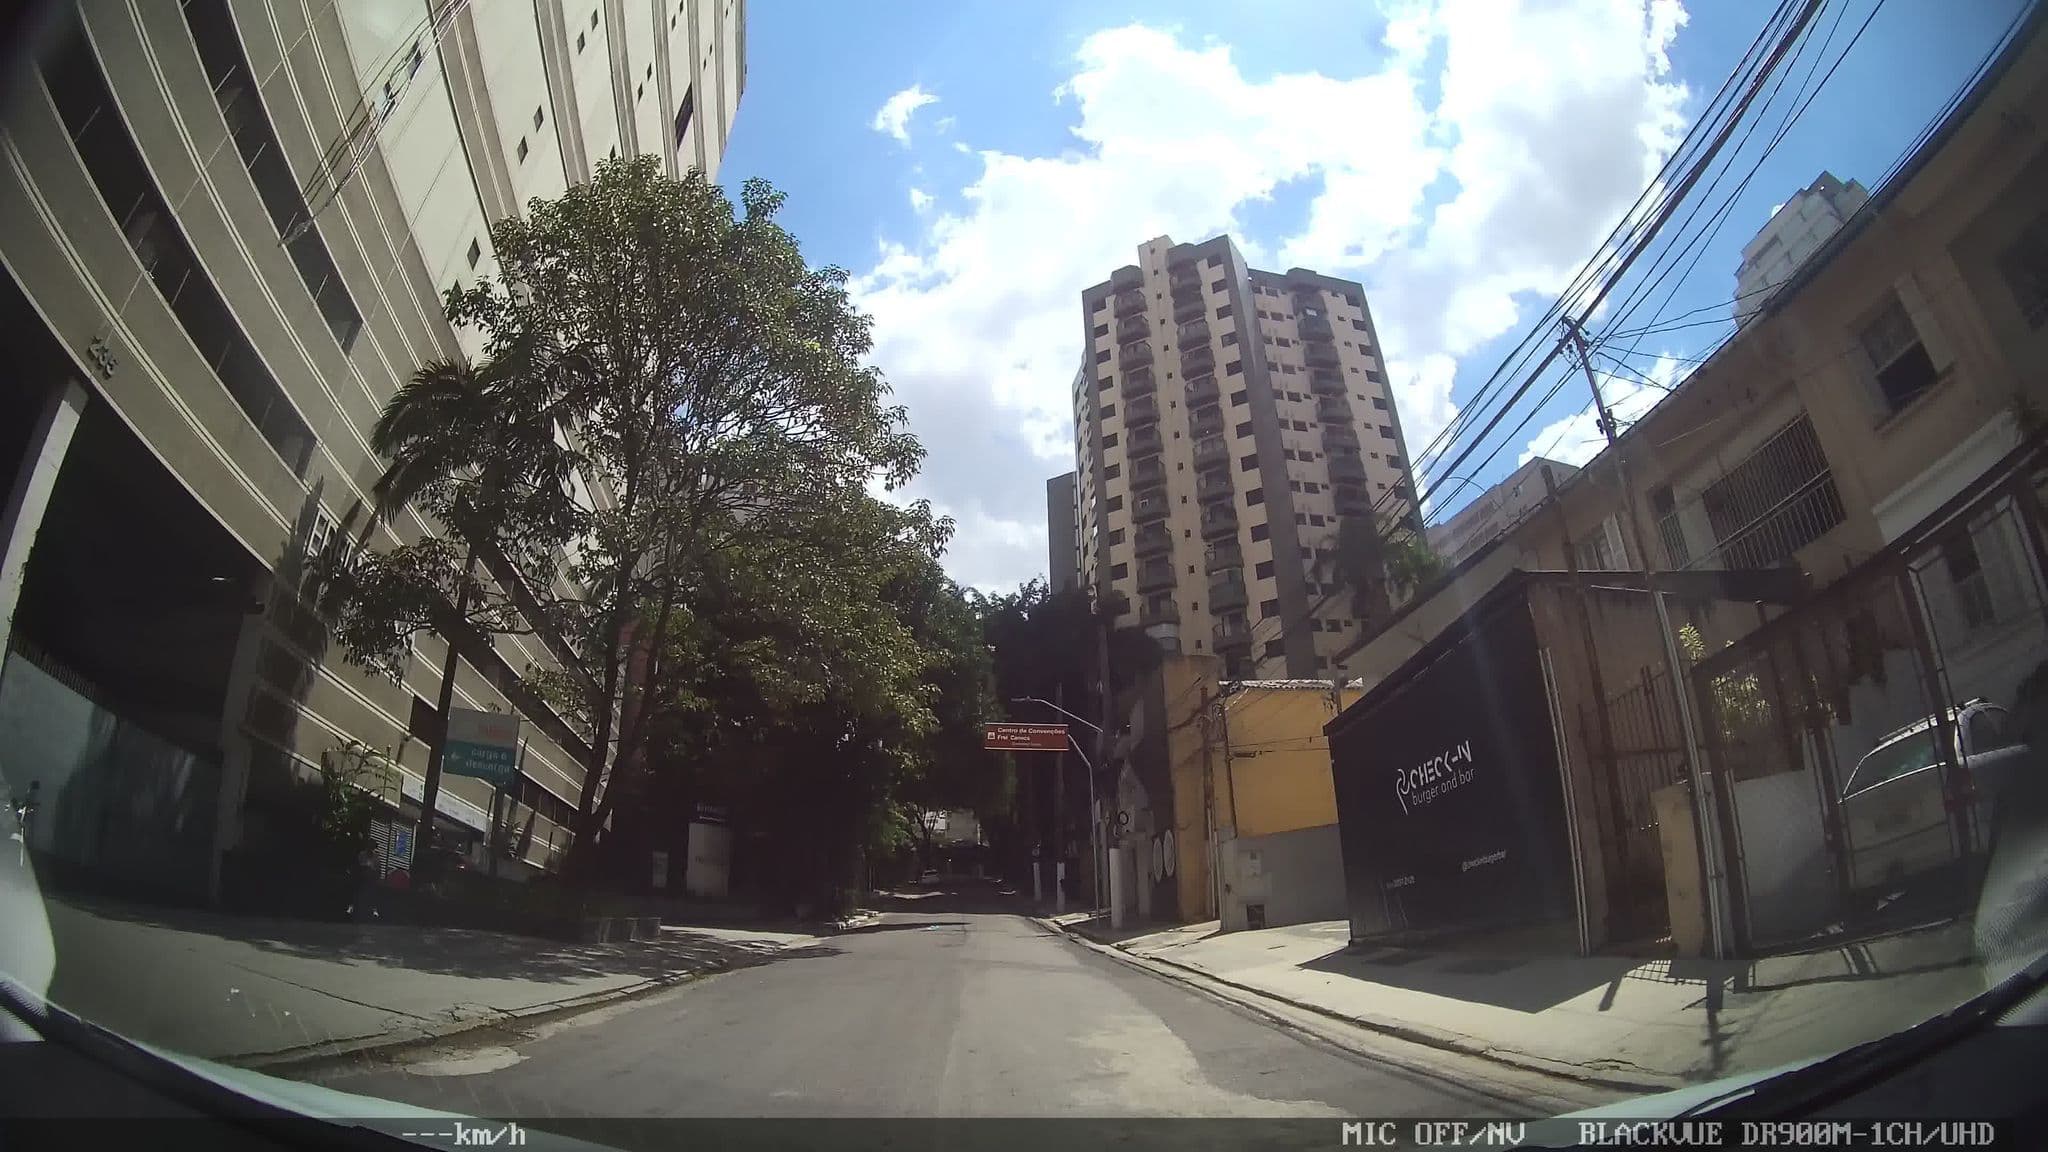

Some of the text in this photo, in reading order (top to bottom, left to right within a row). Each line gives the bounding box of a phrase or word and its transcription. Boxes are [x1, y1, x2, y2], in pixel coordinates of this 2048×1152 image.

[1412, 768, 1474, 806] burger and bar
